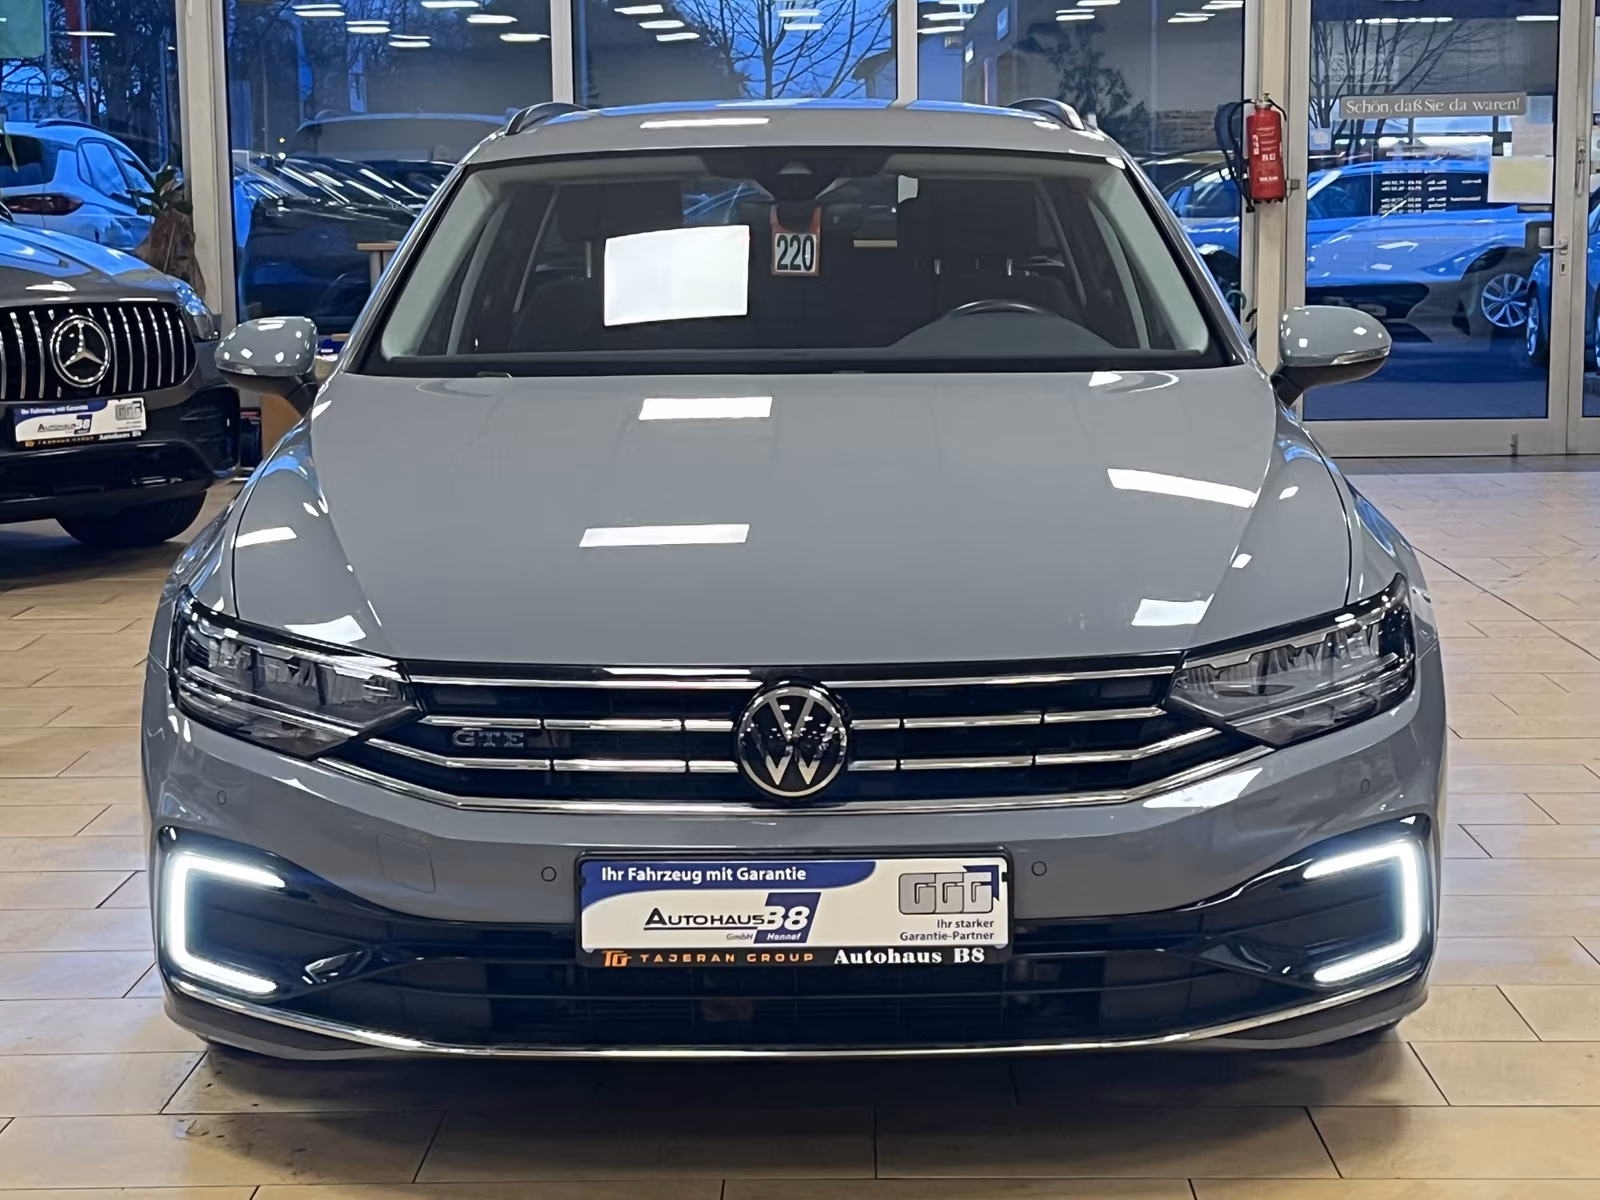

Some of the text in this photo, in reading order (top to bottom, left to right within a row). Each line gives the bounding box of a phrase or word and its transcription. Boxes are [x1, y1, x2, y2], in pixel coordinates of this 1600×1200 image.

[1395, 98, 1422, 113] daß
[1425, 98, 1444, 112] Sie
[1449, 98, 1467, 111] da
[1473, 98, 1520, 111] waren!
[776, 234, 815, 272] 220
[452, 730, 524, 747] GTE
[601, 866, 807, 884] Ihr Fahrzeug mit Garantie
[937, 918, 994, 929] Ihr starker
[726, 932, 753, 941] GmbH
[900, 931, 994, 942] Garantie-Partner
[746, 953, 814, 963] GROUP
[834, 948, 942, 964] Autohaus
[953, 947, 985, 963] B8
